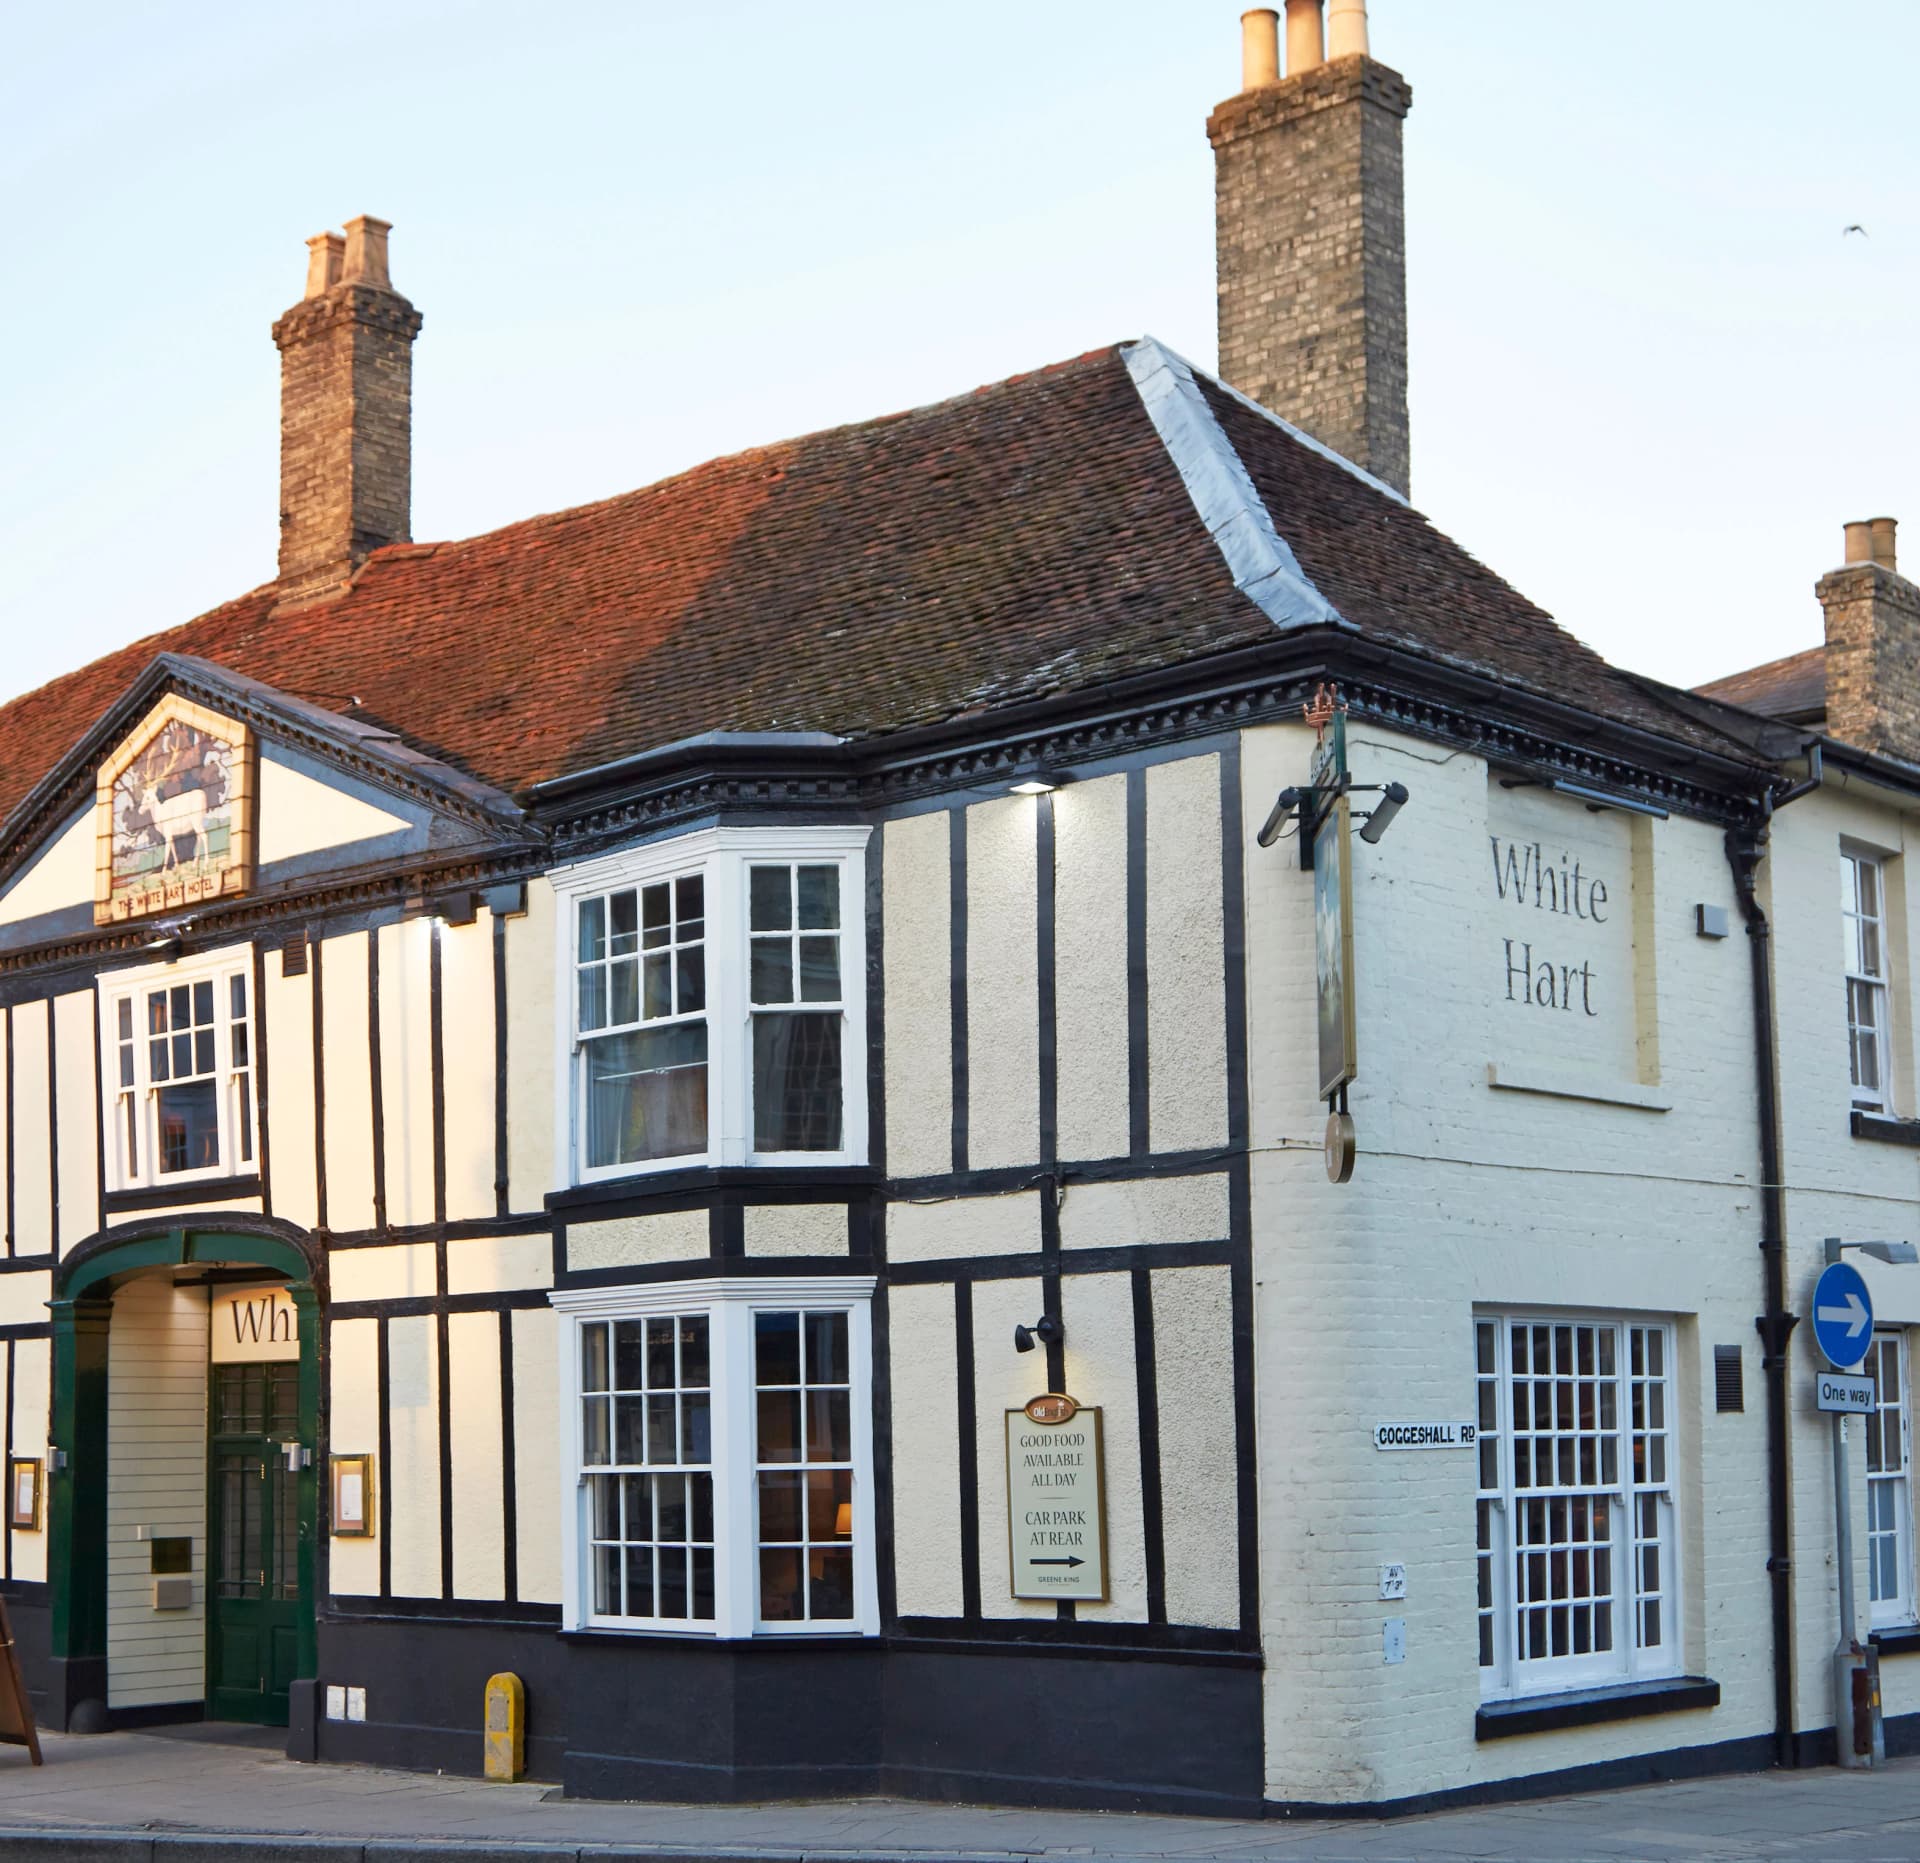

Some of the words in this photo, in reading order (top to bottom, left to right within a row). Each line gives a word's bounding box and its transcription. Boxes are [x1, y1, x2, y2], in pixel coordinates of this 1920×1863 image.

[1489, 835, 1608, 923] White
[118, 898, 134, 912] THE
[187, 879, 213, 895] HOTEL
[1502, 937, 1598, 1017] Hart
[1823, 1383, 1846, 1401] One
[1849, 1389, 1871, 1407] way
[1020, 1434, 1052, 1448] GOOD
[1054, 1433, 1085, 1447] FOOD
[1379, 1425, 1456, 1445] COGGESHALL
[1023, 1453, 1084, 1468] AVAILABLE
[1031, 1474, 1053, 1487] ALL
[1055, 1473, 1077, 1487] DAY
[1025, 1511, 1051, 1525] CAR
[1053, 1511, 1087, 1525] PARK
[1030, 1531, 1046, 1546] AT
[1049, 1531, 1083, 1546] REAR
